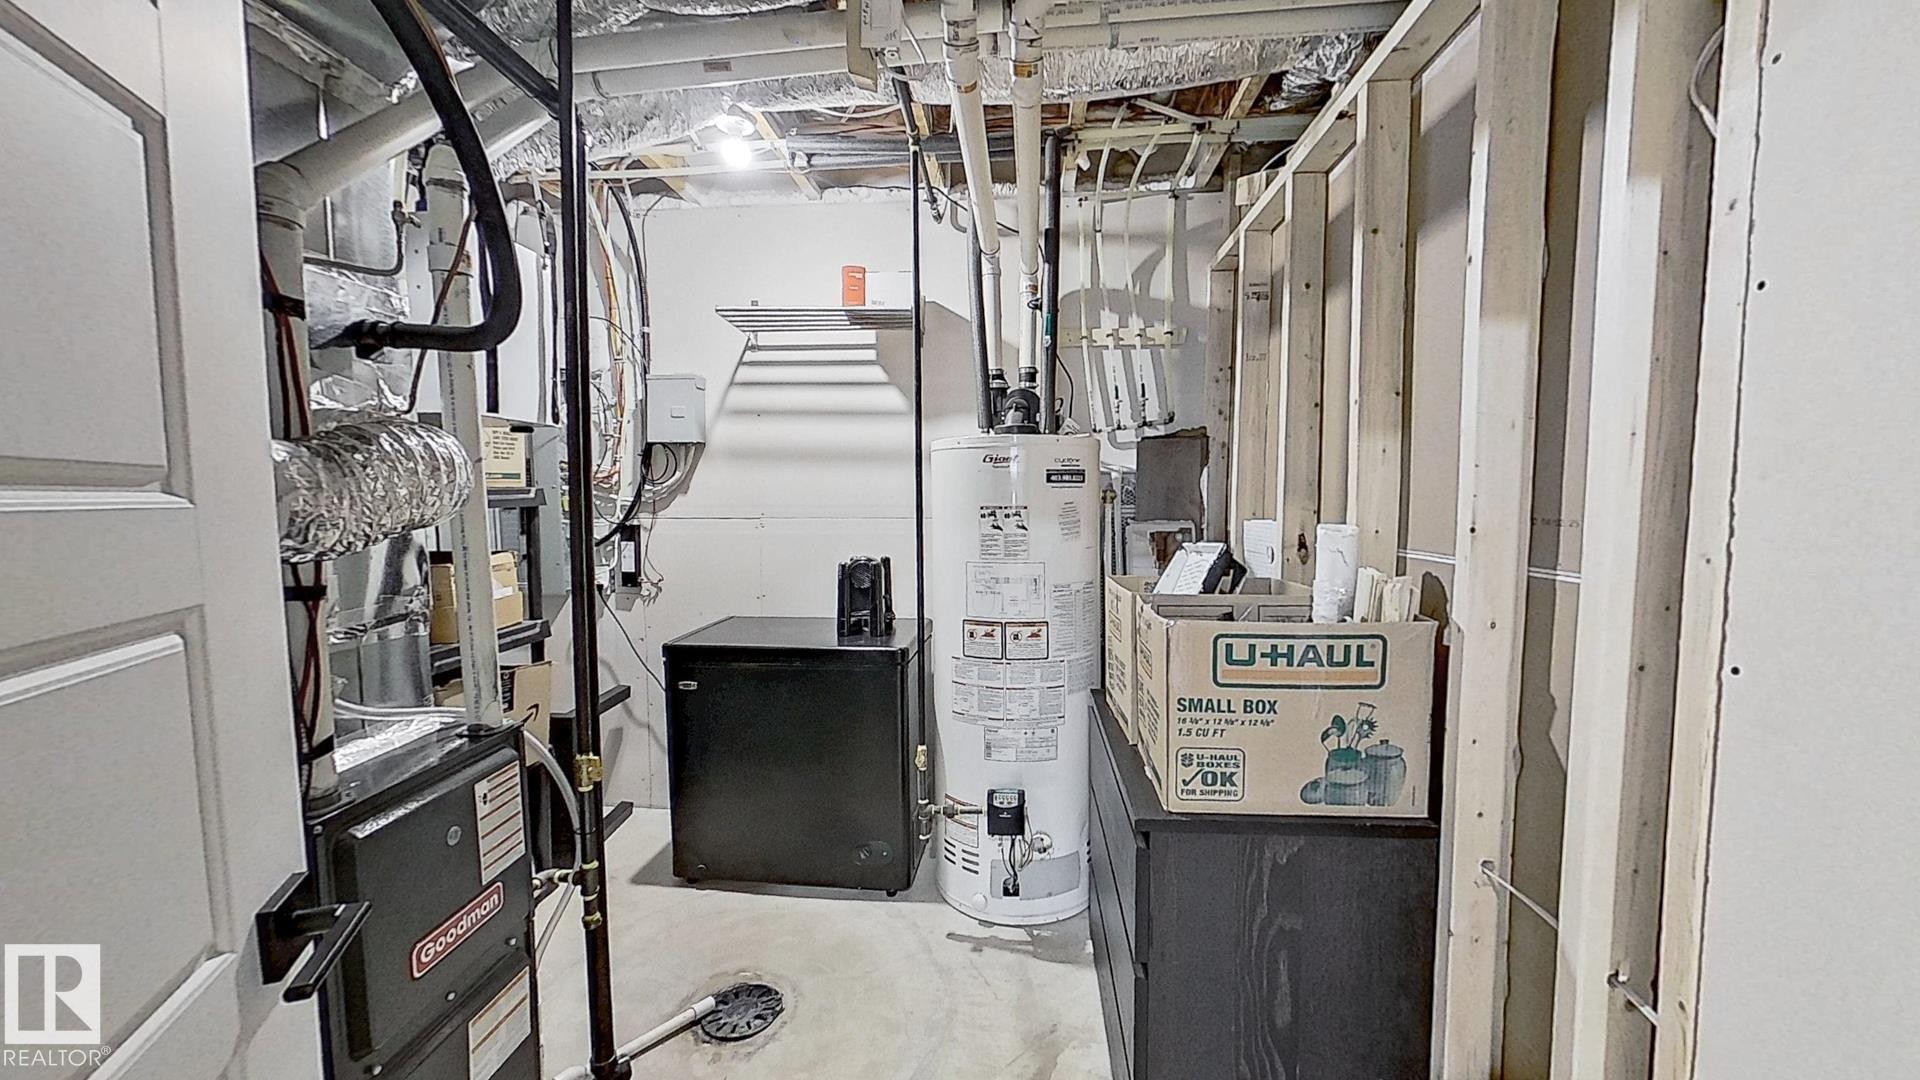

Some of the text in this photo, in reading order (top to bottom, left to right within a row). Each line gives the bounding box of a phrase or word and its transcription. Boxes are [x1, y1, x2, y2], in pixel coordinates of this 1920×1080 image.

[1177, 697, 1278, 715] SMALL BOX
[1177, 717, 1187, 725] 16
[1178, 728, 1227, 738] 1.5 CU FT
[1196, 753, 1240, 761] U-HAUL
[1196, 761, 1240, 769] BOXES
[1201, 771, 1238, 787] OK
[1180, 788, 1238, 797] FOR SHIPPING
[420, 891, 499, 963] Goodman
